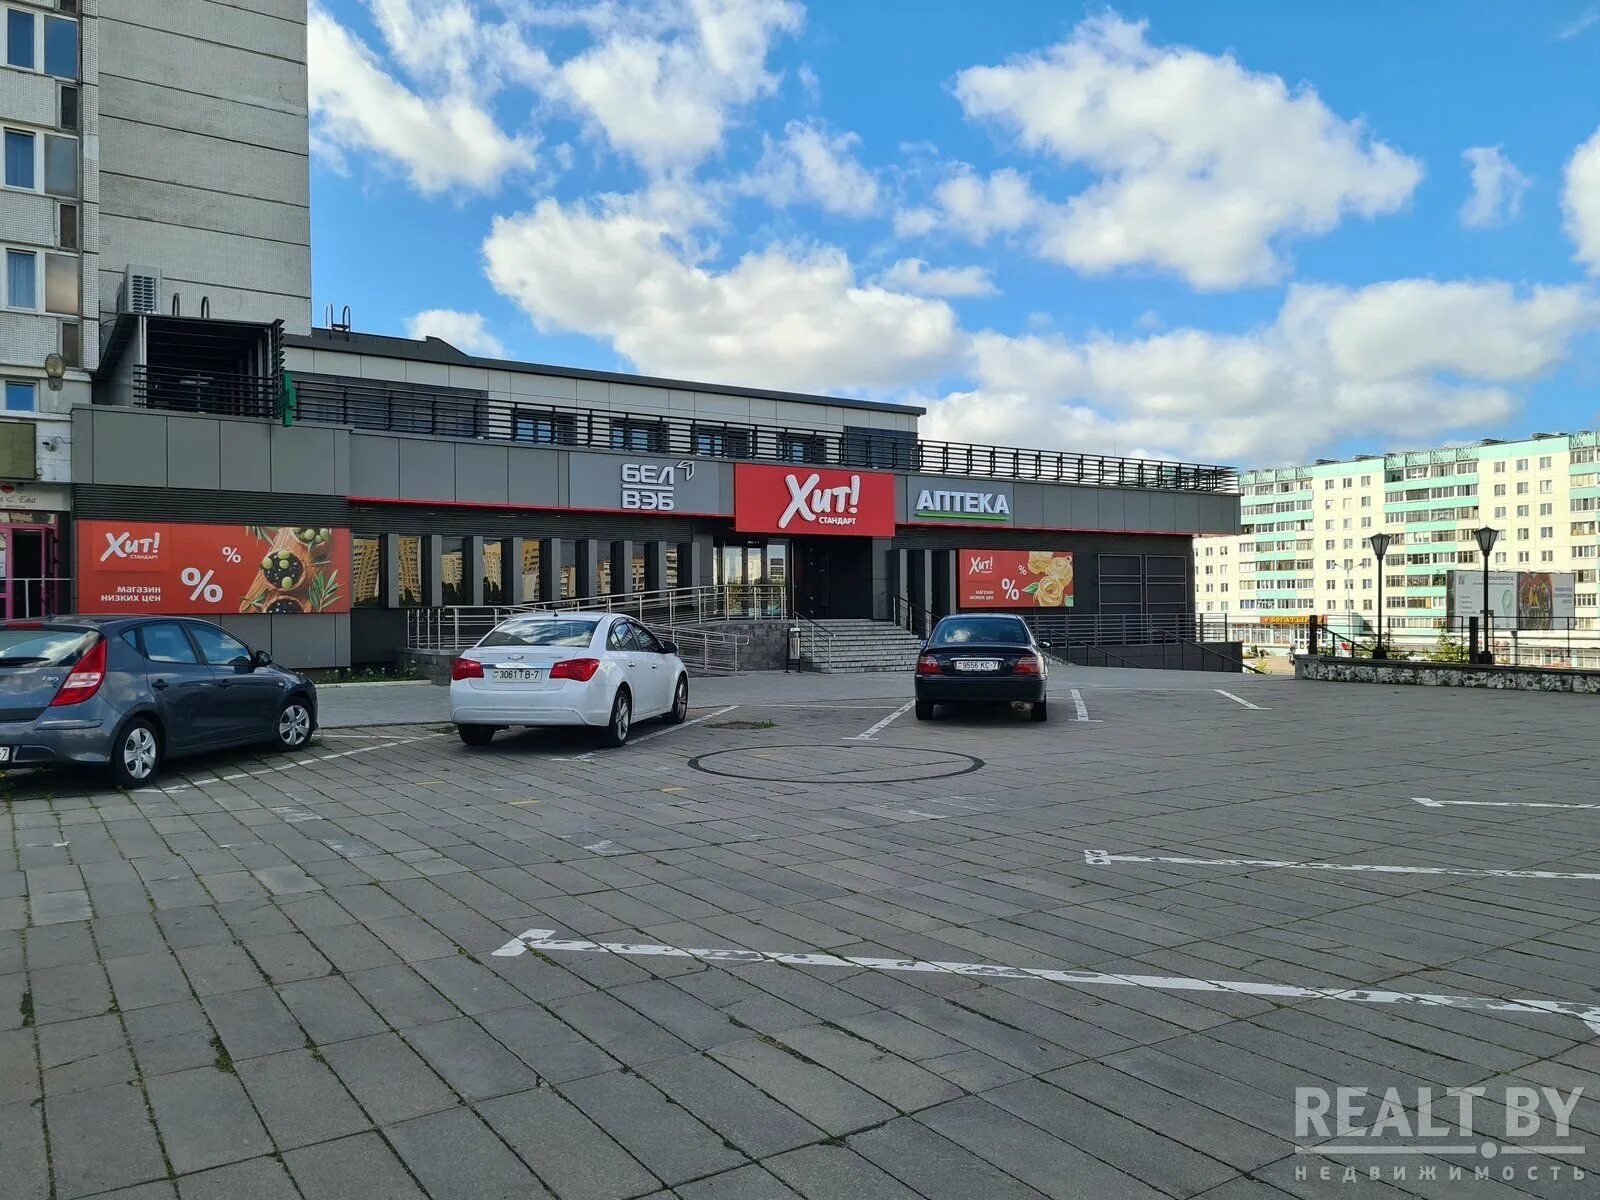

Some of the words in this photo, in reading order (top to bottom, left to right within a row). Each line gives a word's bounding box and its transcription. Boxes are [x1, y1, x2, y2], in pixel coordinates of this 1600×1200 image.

[621, 463, 675, 485] БЕЛ
[621, 490, 675, 511] ВЭБ
[777, 473, 861, 529] Хит!
[916, 489, 1010, 514] АПТЕКА
[818, 516, 857, 526] СТАНДАРТ
[100, 531, 161, 562] Хит!
[968, 556, 994, 576] Хит!
[117, 586, 161, 594] магазин
[101, 594, 140, 602] низких
[142, 594, 161, 603] цен
[1270, 615, 1310, 623] БОГАТЫР
[962, 661, 978, 669] 9556
[499, 670, 518, 679] 3061
[519, 670, 539, 679] TB-7
